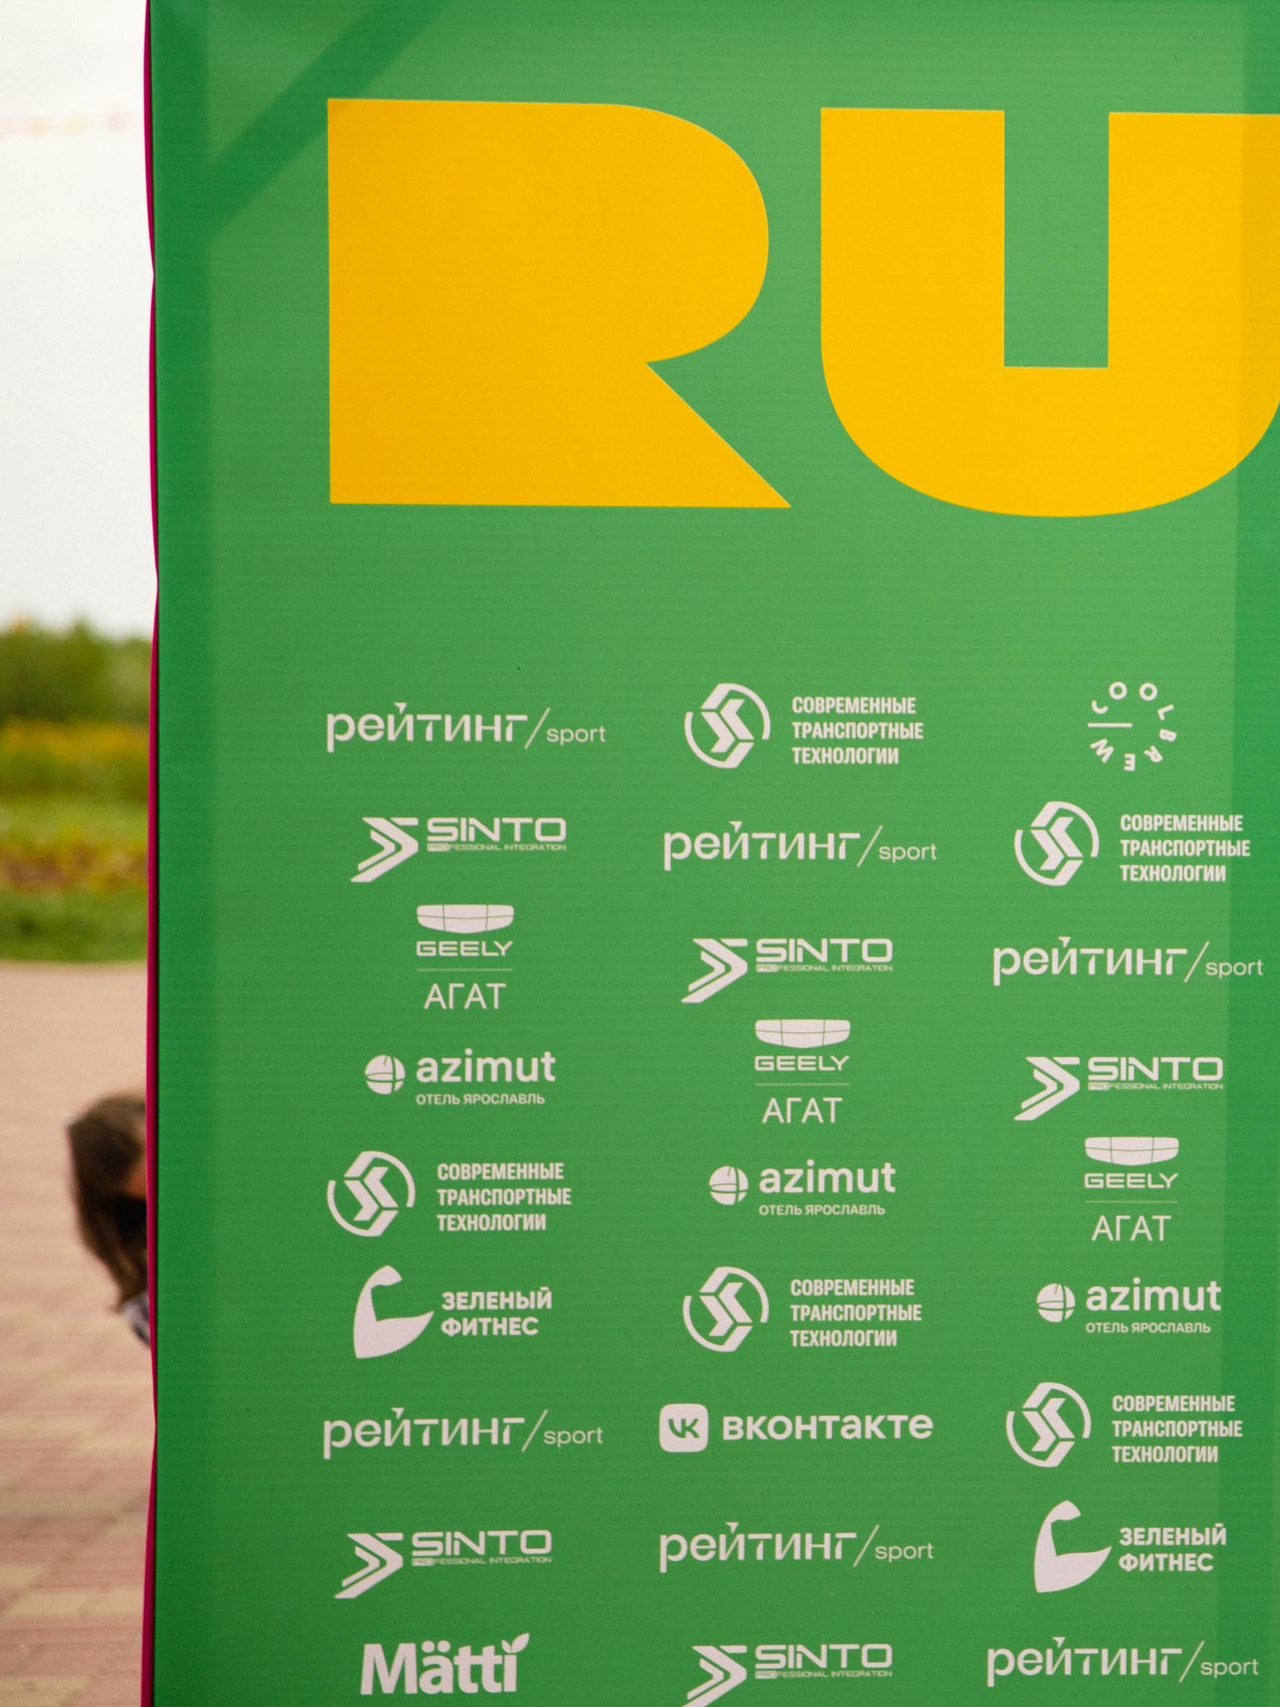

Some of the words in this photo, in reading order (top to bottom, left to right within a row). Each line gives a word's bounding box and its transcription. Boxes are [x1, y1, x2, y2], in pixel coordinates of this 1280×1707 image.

[792, 697, 916, 714] СОВРЕМЕННЫЕ
[792, 722, 923, 739] ТРАНСПОРТНЫЕ
[792, 747, 898, 764] ТЕХНОЛОГИИ
[427, 818, 566, 842] SINTO
[1120, 814, 1242, 831] СОВРЕМЕННЫЕ
[504, 843, 566, 851] INTEGRATION
[1120, 839, 1250, 856] ТРАНСПОРТНЫЕ
[1120, 865, 1226, 881] ТЕХНОЛОГИИ
[417, 941, 512, 956] GEELY
[756, 938, 892, 962] SINTO
[831, 964, 893, 972] INTEGRATION
[424, 983, 506, 1009] АГАТ
[417, 1048, 555, 1082] azimut
[755, 1056, 849, 1071] GEELY
[1088, 1057, 1223, 1081] SINTO
[1162, 1083, 1223, 1091] INTEGRATION
[416, 1094, 460, 1105] ОТЕЛЬ
[464, 1094, 545, 1104] ЯРОСЛАВЛЬ
[762, 1097, 842, 1123] АГАТ
[438, 1163, 564, 1180] СОВРЕМЕННЫЕ
[759, 1159, 896, 1193] azimut
[1084, 1173, 1178, 1188] GEELY
[437, 1188, 571, 1205] ТРАНСПОРТНЫЕ
[759, 1205, 802, 1215] ОТЕЛЬ
[805, 1204, 885, 1215] ЯРОСЛАВЛЬ
[437, 1214, 546, 1231] ТЕХНОЛОГИИ
[1092, 1215, 1171, 1241] АГАТ
[791, 1279, 914, 1296] СОВРЕМЕННЫЕ
[1086, 1277, 1221, 1311] azimut
[442, 1287, 552, 1310] ЗЕЛЕНЫЙ
[790, 1304, 921, 1321] ТРАНСПОРТНЫЕ
[441, 1317, 538, 1336] ФИТНЕС
[1086, 1322, 1128, 1333] ОТЕЛЬ
[1131, 1322, 1211, 1333] ЯРОСЛАВЛЬ
[790, 1330, 897, 1346] ТЕХНОЛОГИИ
[1112, 1395, 1235, 1411] СОВРЕМЕННЫЕ
[723, 1415, 933, 1440] вконтакте
[1112, 1420, 1242, 1437] ТРАНСПОРТНЫЕ
[1112, 1446, 1218, 1462] ТЕХНОЛОГИИ
[412, 1530, 552, 1554] SINTO
[1120, 1523, 1226, 1545] ЗЕЛЕНЫЙ
[489, 1556, 552, 1564] INTEGRATION
[1119, 1553, 1213, 1571] ФИТНЕС
[361, 1633, 529, 1694] Mätti
[755, 1644, 892, 1668] SINTO
[831, 1670, 892, 1678] INTEGRATION
